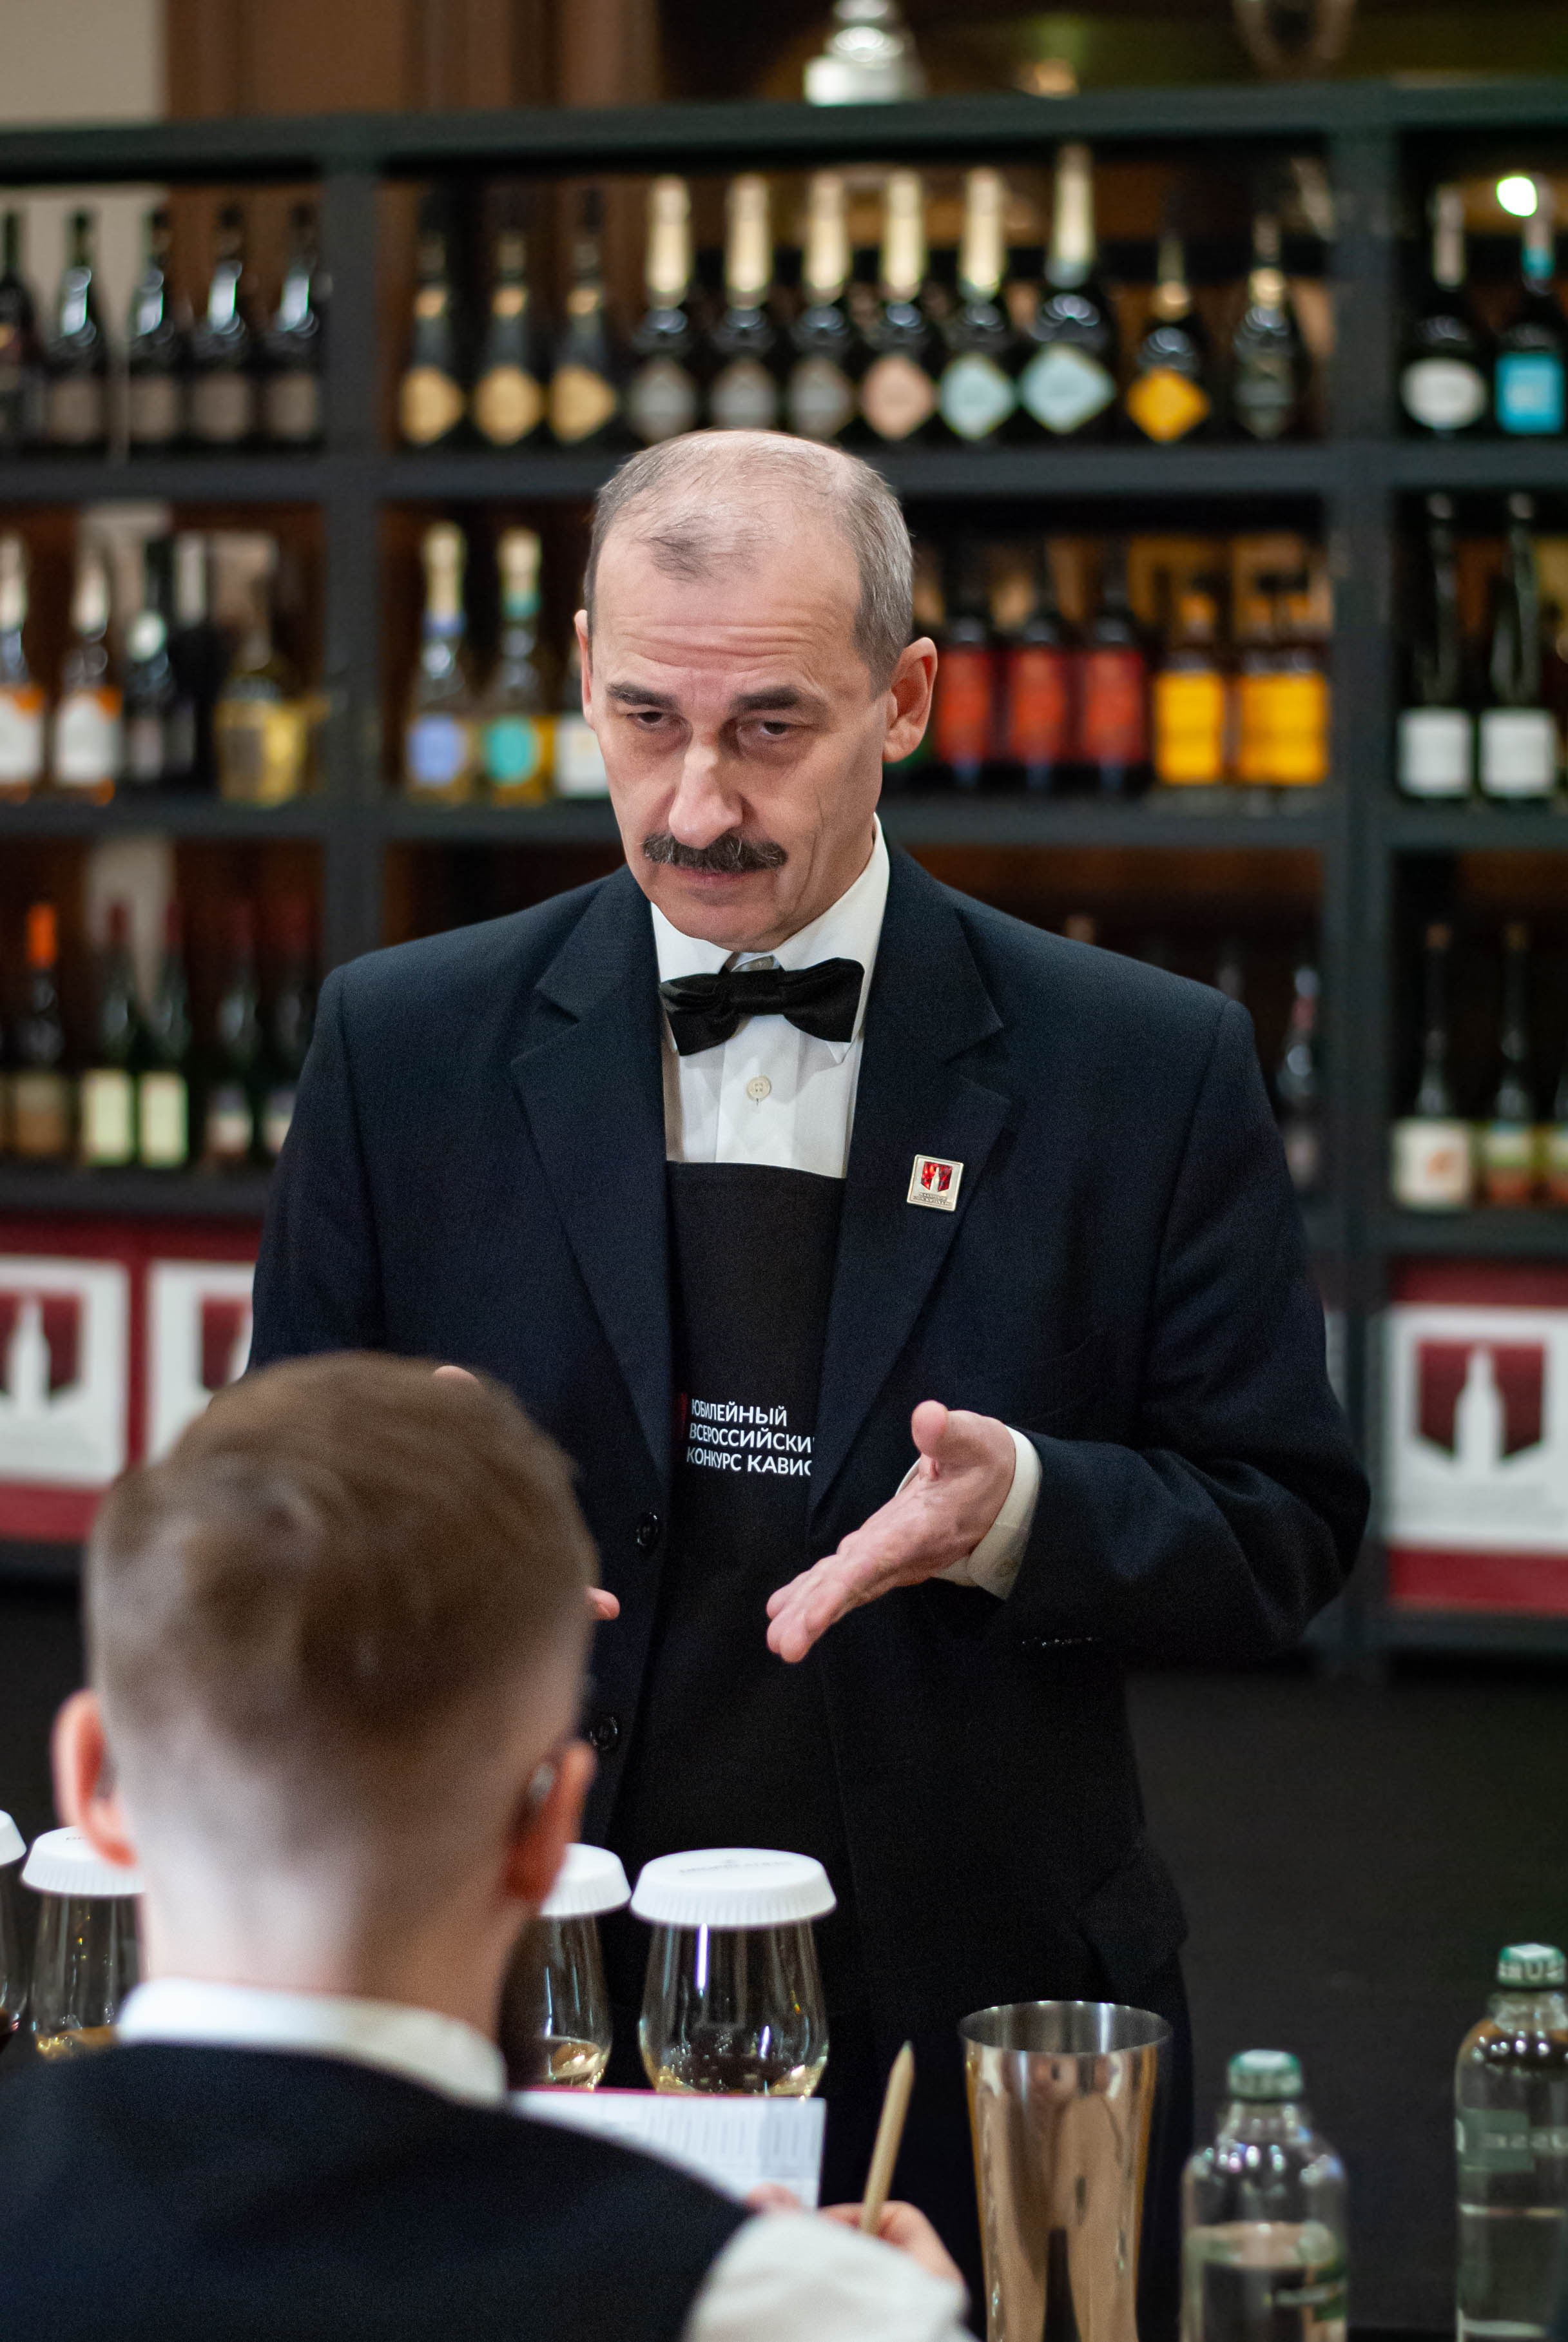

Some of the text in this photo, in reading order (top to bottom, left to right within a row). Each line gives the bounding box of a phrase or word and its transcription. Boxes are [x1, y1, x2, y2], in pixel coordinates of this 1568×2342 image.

[692, 1398, 787, 1427] ЮБИЛЕЙНЫЙ
[689, 1422, 815, 1453] ВСЕРОССИЙСКИ
[686, 1446, 812, 1476] КОНКУРС КАВИС
